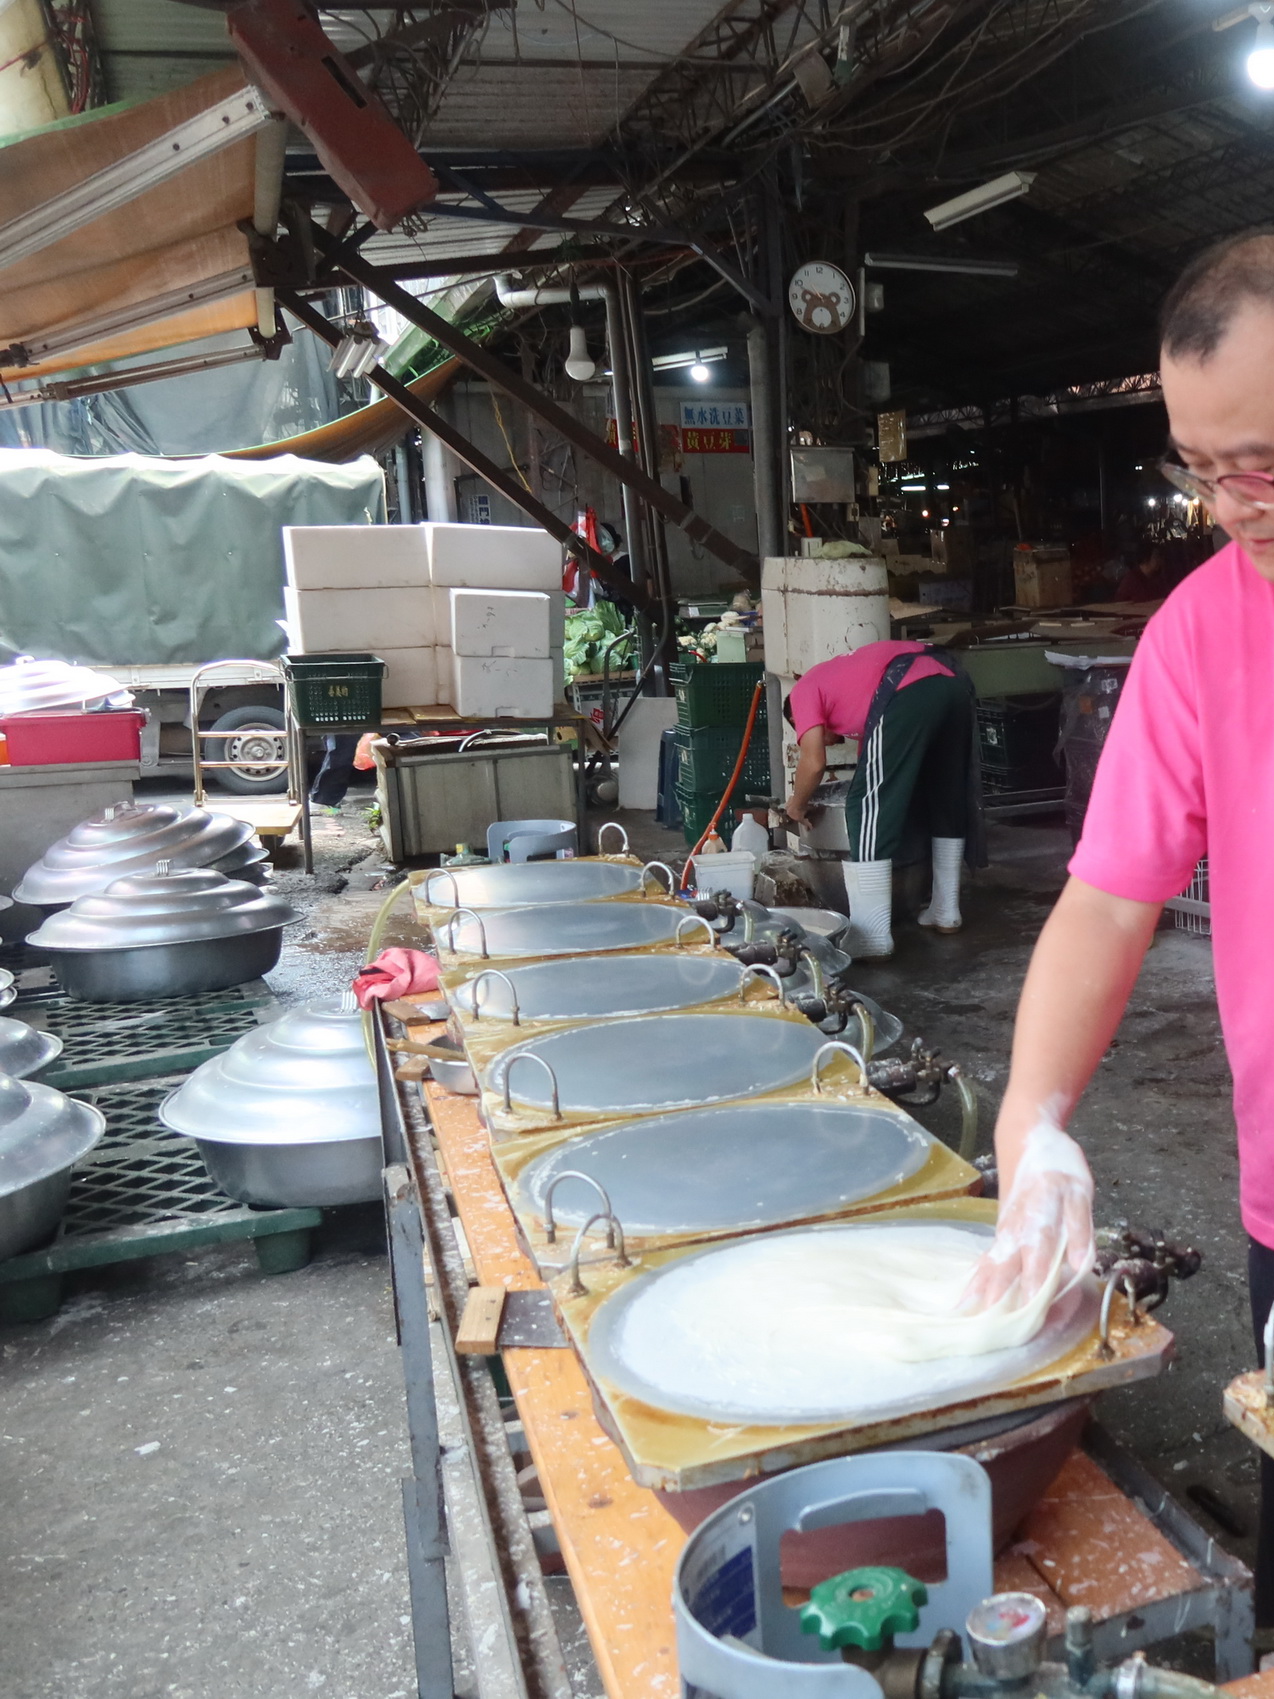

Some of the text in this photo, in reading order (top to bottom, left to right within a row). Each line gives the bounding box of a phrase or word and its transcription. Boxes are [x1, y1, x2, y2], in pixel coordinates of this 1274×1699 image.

[815, 266, 823, 274] 12
[794, 279, 803, 287] 10
[791, 292, 798, 300] 9
[684, 406, 745, 426] 無水洗豆菜
[687, 431, 732, 450] 黃豆芽
